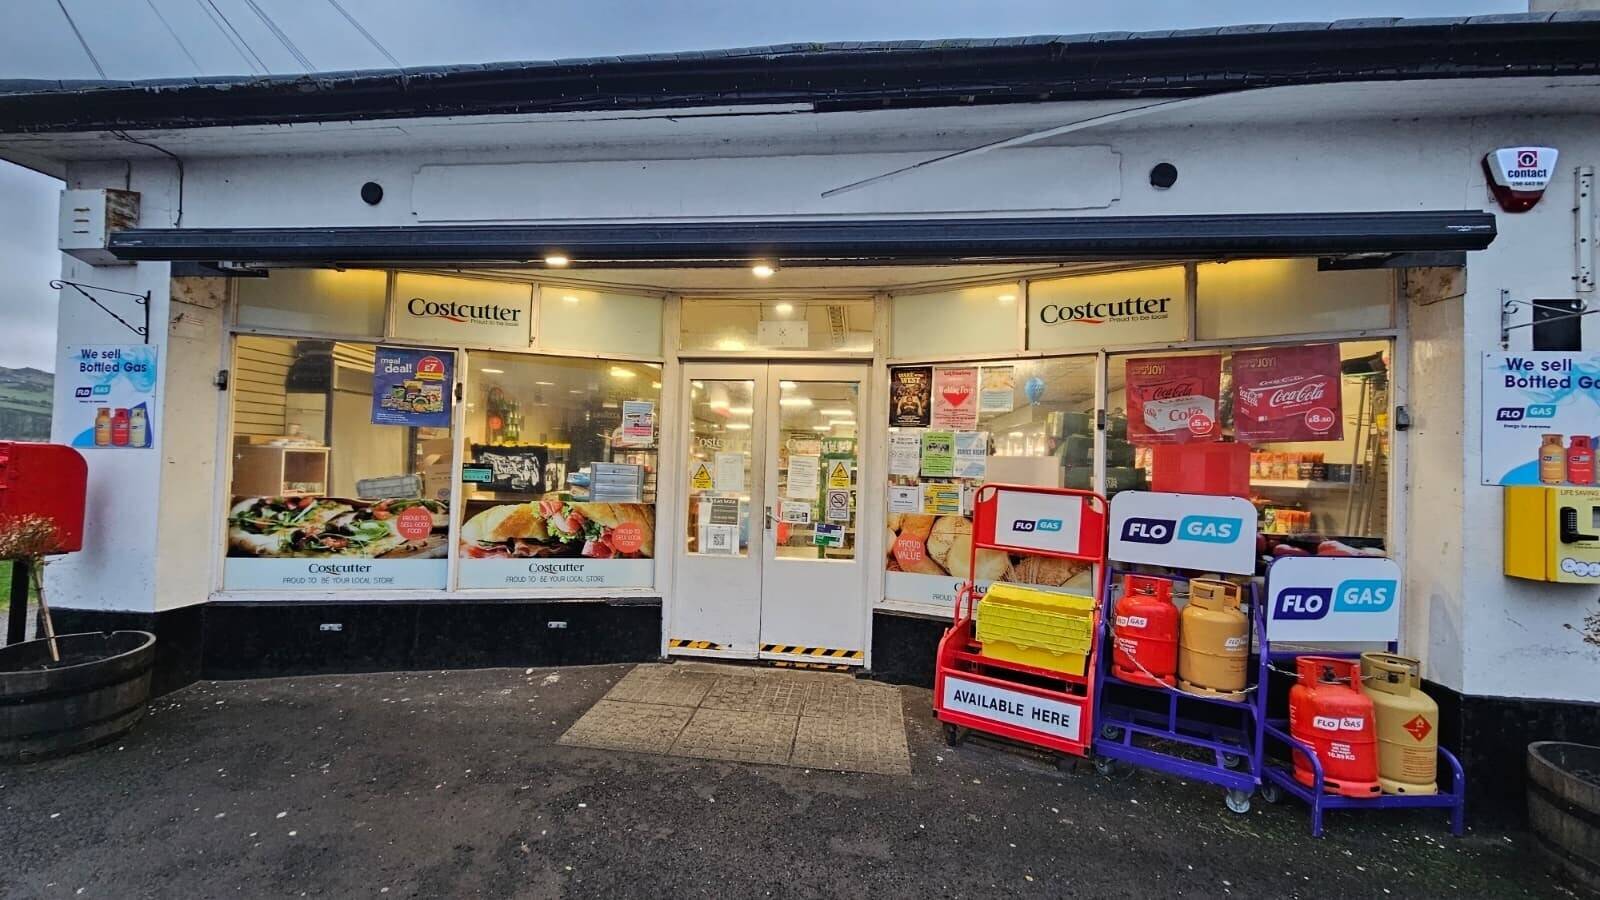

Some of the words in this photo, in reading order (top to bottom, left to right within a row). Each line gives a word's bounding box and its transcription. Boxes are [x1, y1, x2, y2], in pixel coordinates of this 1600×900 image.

[1508, 169, 1547, 178] contact
[408, 298, 521, 321] Costcutter
[1040, 297, 1171, 323] Costcutter
[81, 349, 98, 359] We
[102, 349, 121, 359] sell
[80, 362, 120, 373] Bottled
[124, 362, 147, 373] Gas
[385, 364, 412, 373] deal!
[1505, 357, 1535, 371] We
[1541, 358, 1572, 371] sell
[1504, 375, 1571, 388] Bottled
[1269, 382, 1327, 407] Coca-Cola
[1500, 410, 1521, 418] FLO
[1530, 407, 1552, 416] GAS
[1016, 522, 1032, 530] FLO
[1040, 521, 1058, 529] GAS
[1128, 522, 1167, 539] FLO
[1187, 521, 1232, 538] GAS
[898, 540, 920, 549] PROUD
[898, 552, 920, 560] VALUE
[308, 563, 372, 573] Costcutter
[529, 563, 584, 573] Costcutter
[1281, 594, 1323, 613] FLO
[1343, 587, 1388, 605] GAS
[1131, 618, 1145, 626] GAS
[953, 689, 1025, 717] AVAILABLE
[1031, 707, 1070, 728] HERE
[1317, 719, 1336, 728] FLO
[1343, 720, 1361, 728] GAS
